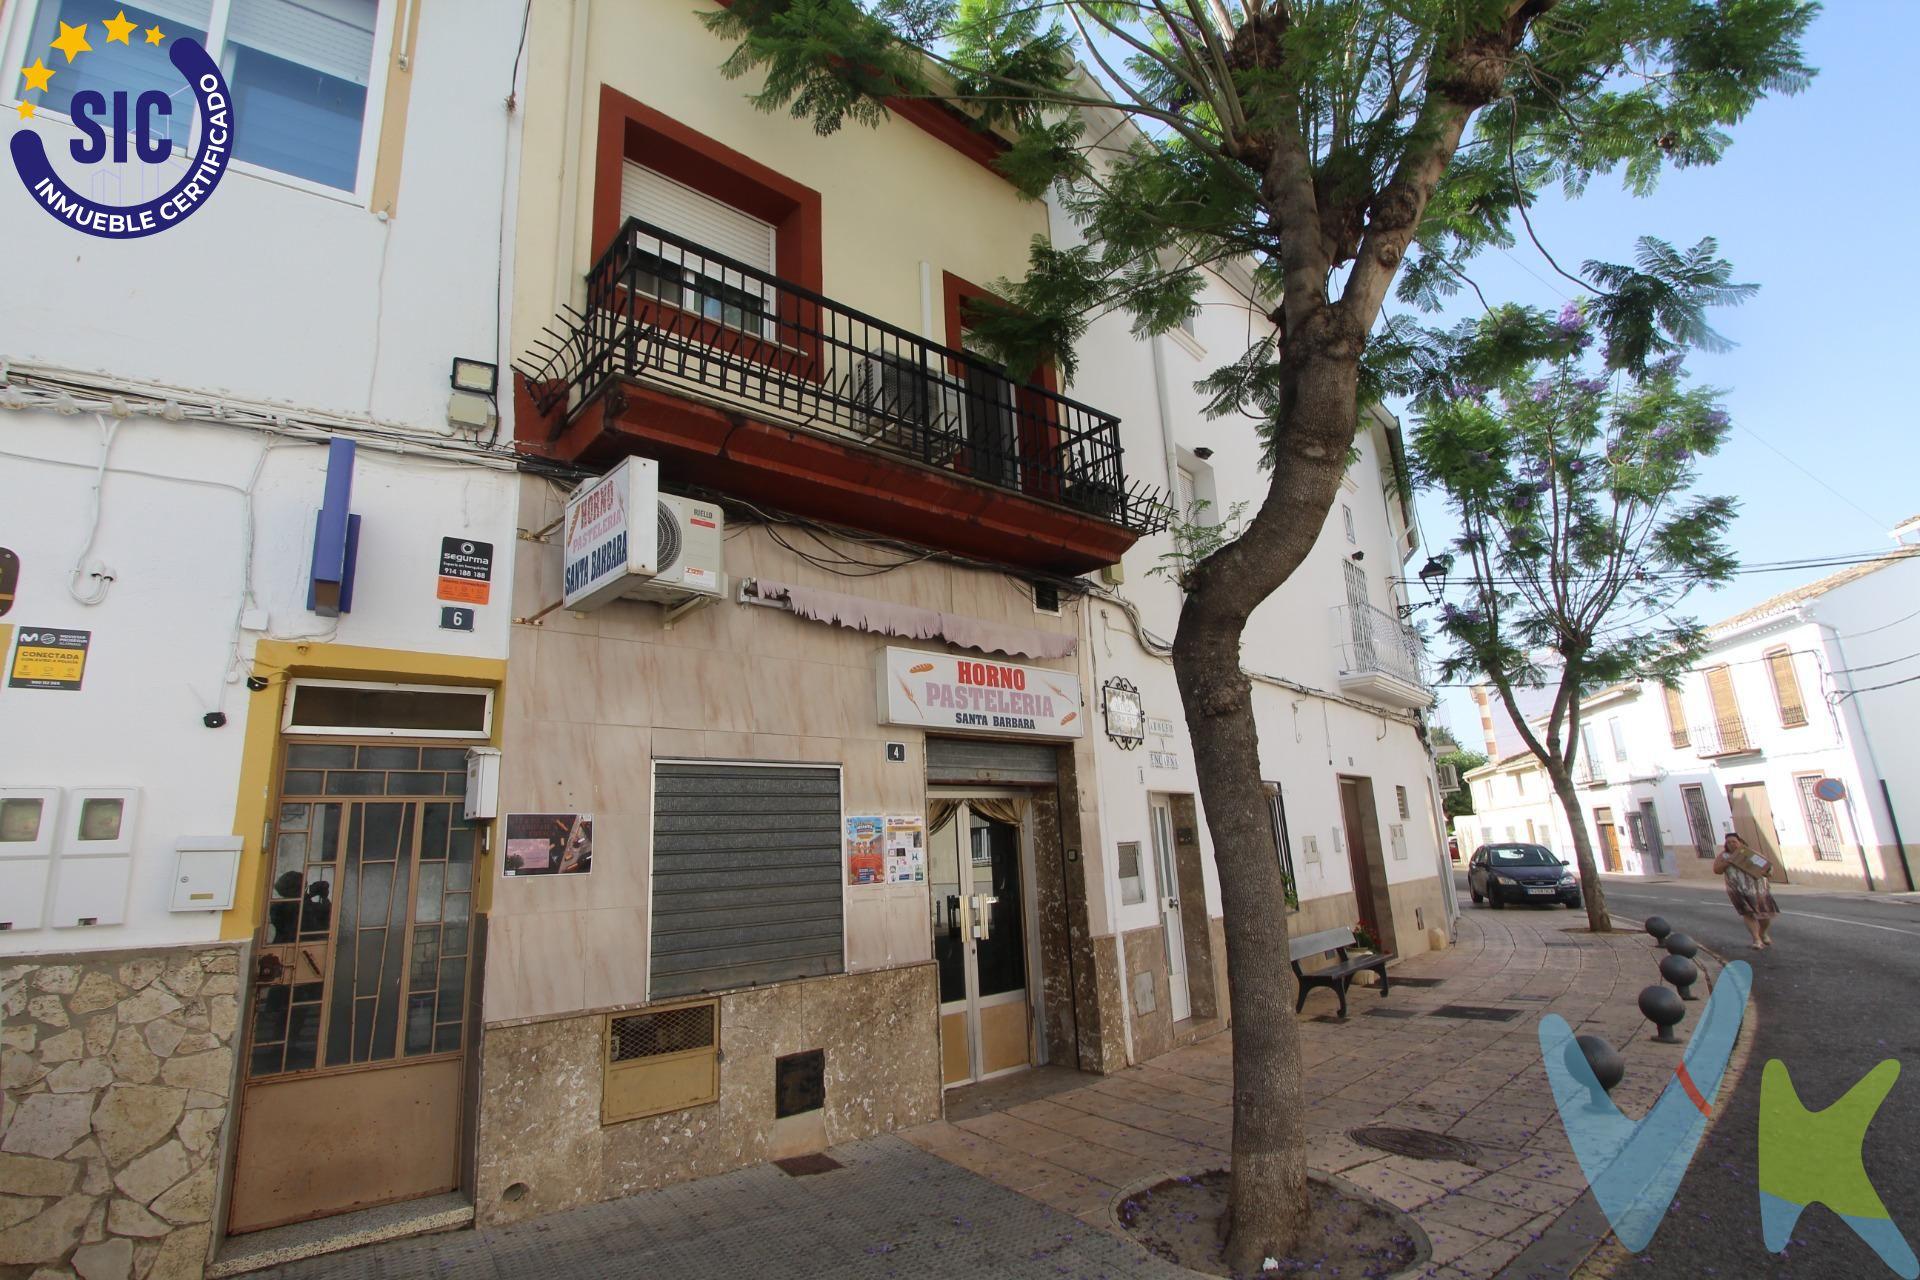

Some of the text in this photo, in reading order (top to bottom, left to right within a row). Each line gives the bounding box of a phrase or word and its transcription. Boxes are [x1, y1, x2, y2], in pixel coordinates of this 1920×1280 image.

[580, 480, 614, 530] HORNO
[572, 509, 621, 553] PASTELERIA
[443, 552, 489, 565] segurma
[565, 530, 627, 596] SANTA BARBARA
[444, 567, 457, 575] 914
[453, 611, 462, 626] 6
[22, 651, 80, 660] CONECTADA
[957, 661, 1026, 691] HORNO
[926, 682, 1055, 718] PASTELERIA
[955, 712, 1036, 730] SANTA BARBARA
[893, 747, 900, 759] 4
